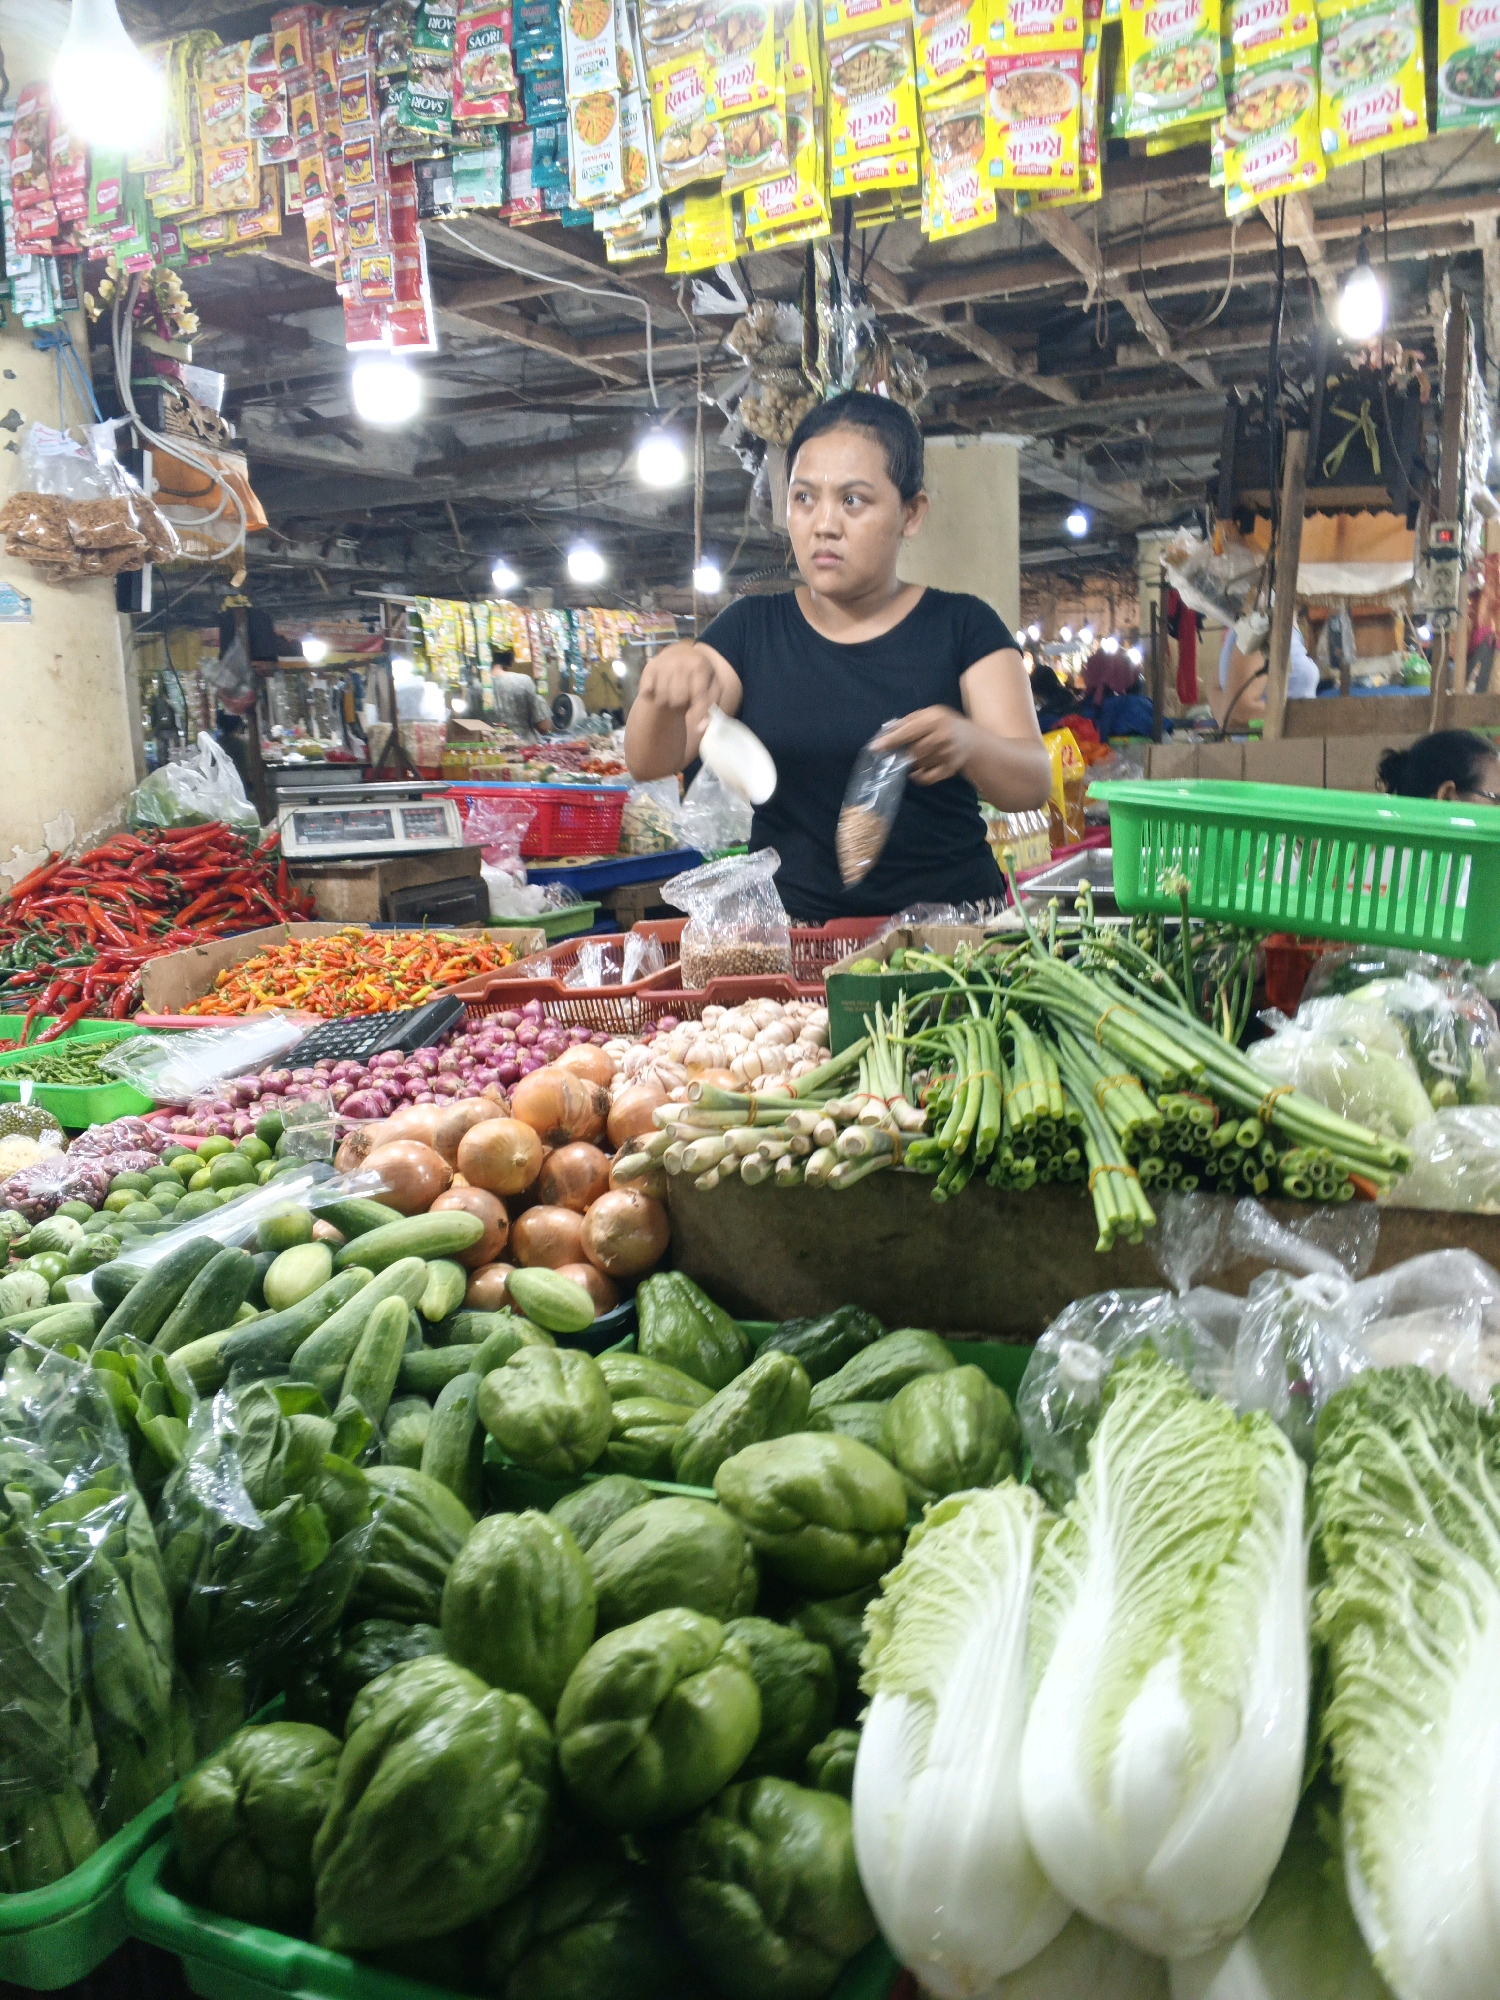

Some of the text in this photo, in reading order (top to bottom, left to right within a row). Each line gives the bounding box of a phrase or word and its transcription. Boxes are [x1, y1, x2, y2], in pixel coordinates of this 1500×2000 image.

[1144, 0, 1201, 36] Racik
[469, 30, 501, 49] SAORI
[927, 24, 970, 65] Racik
[665, 77, 705, 114] Racik
[714, 62, 756, 98] Racik
[410, 96, 445, 113] SAORI
[847, 104, 896, 138] Racik
[1340, 86, 1400, 130] Racik
[1008, 136, 1061, 162] Racik
[1242, 135, 1298, 178] Racik
[758, 172, 797, 208] Racik
